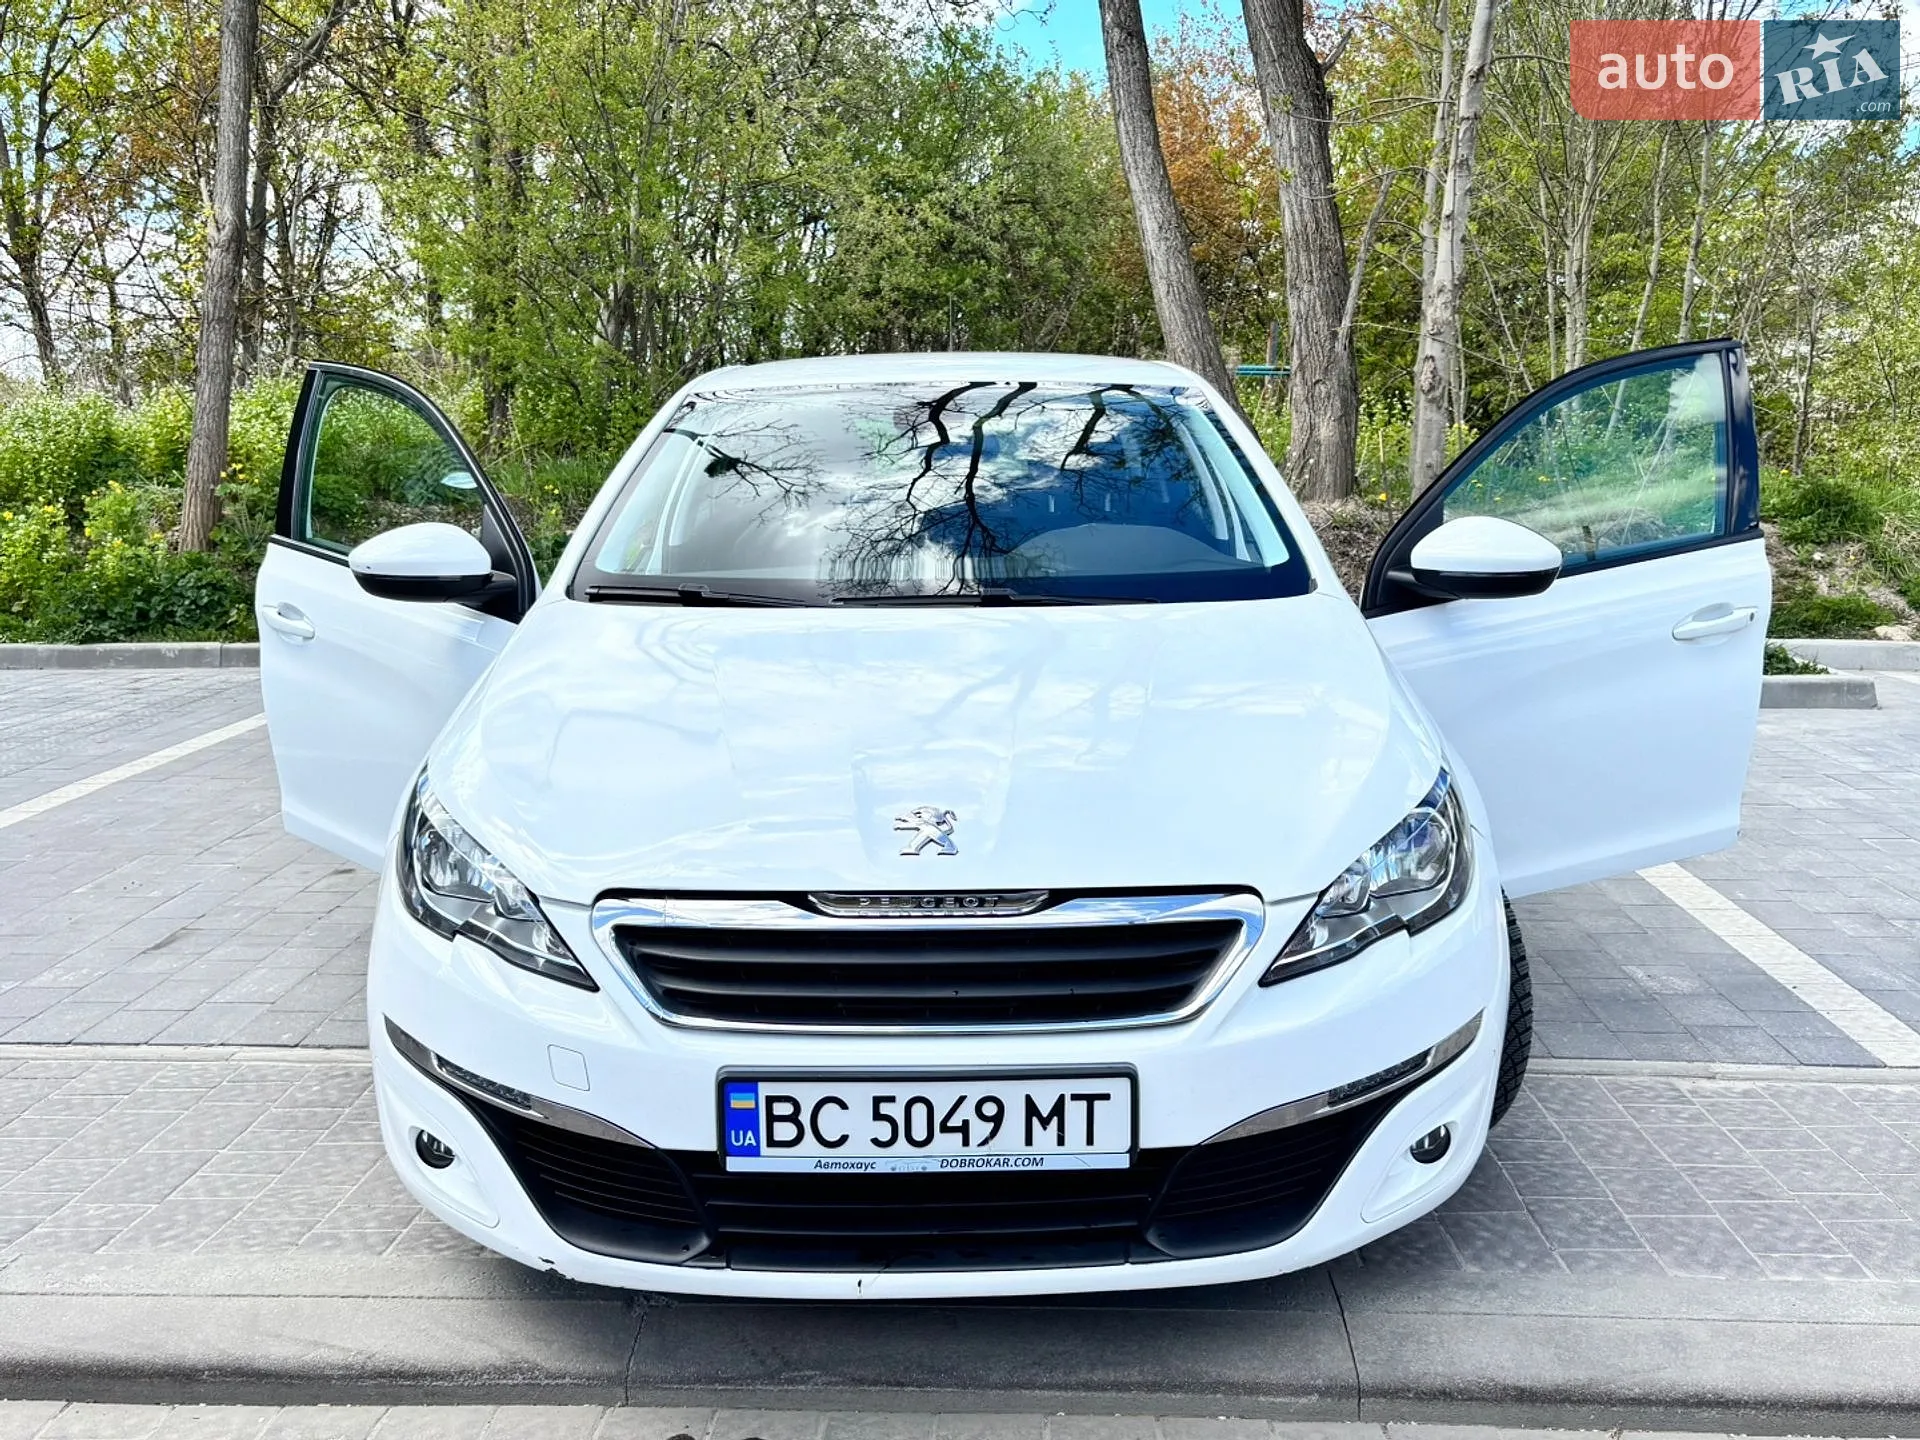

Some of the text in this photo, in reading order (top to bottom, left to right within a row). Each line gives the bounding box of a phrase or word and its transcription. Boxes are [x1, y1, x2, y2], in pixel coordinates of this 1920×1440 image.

[764, 1093, 1111, 1149] BC 5049 MT
[731, 1130, 757, 1147] UA
[814, 1160, 877, 1172] Автохаус
[940, 1156, 1045, 1169] DOBROKAR.COM
